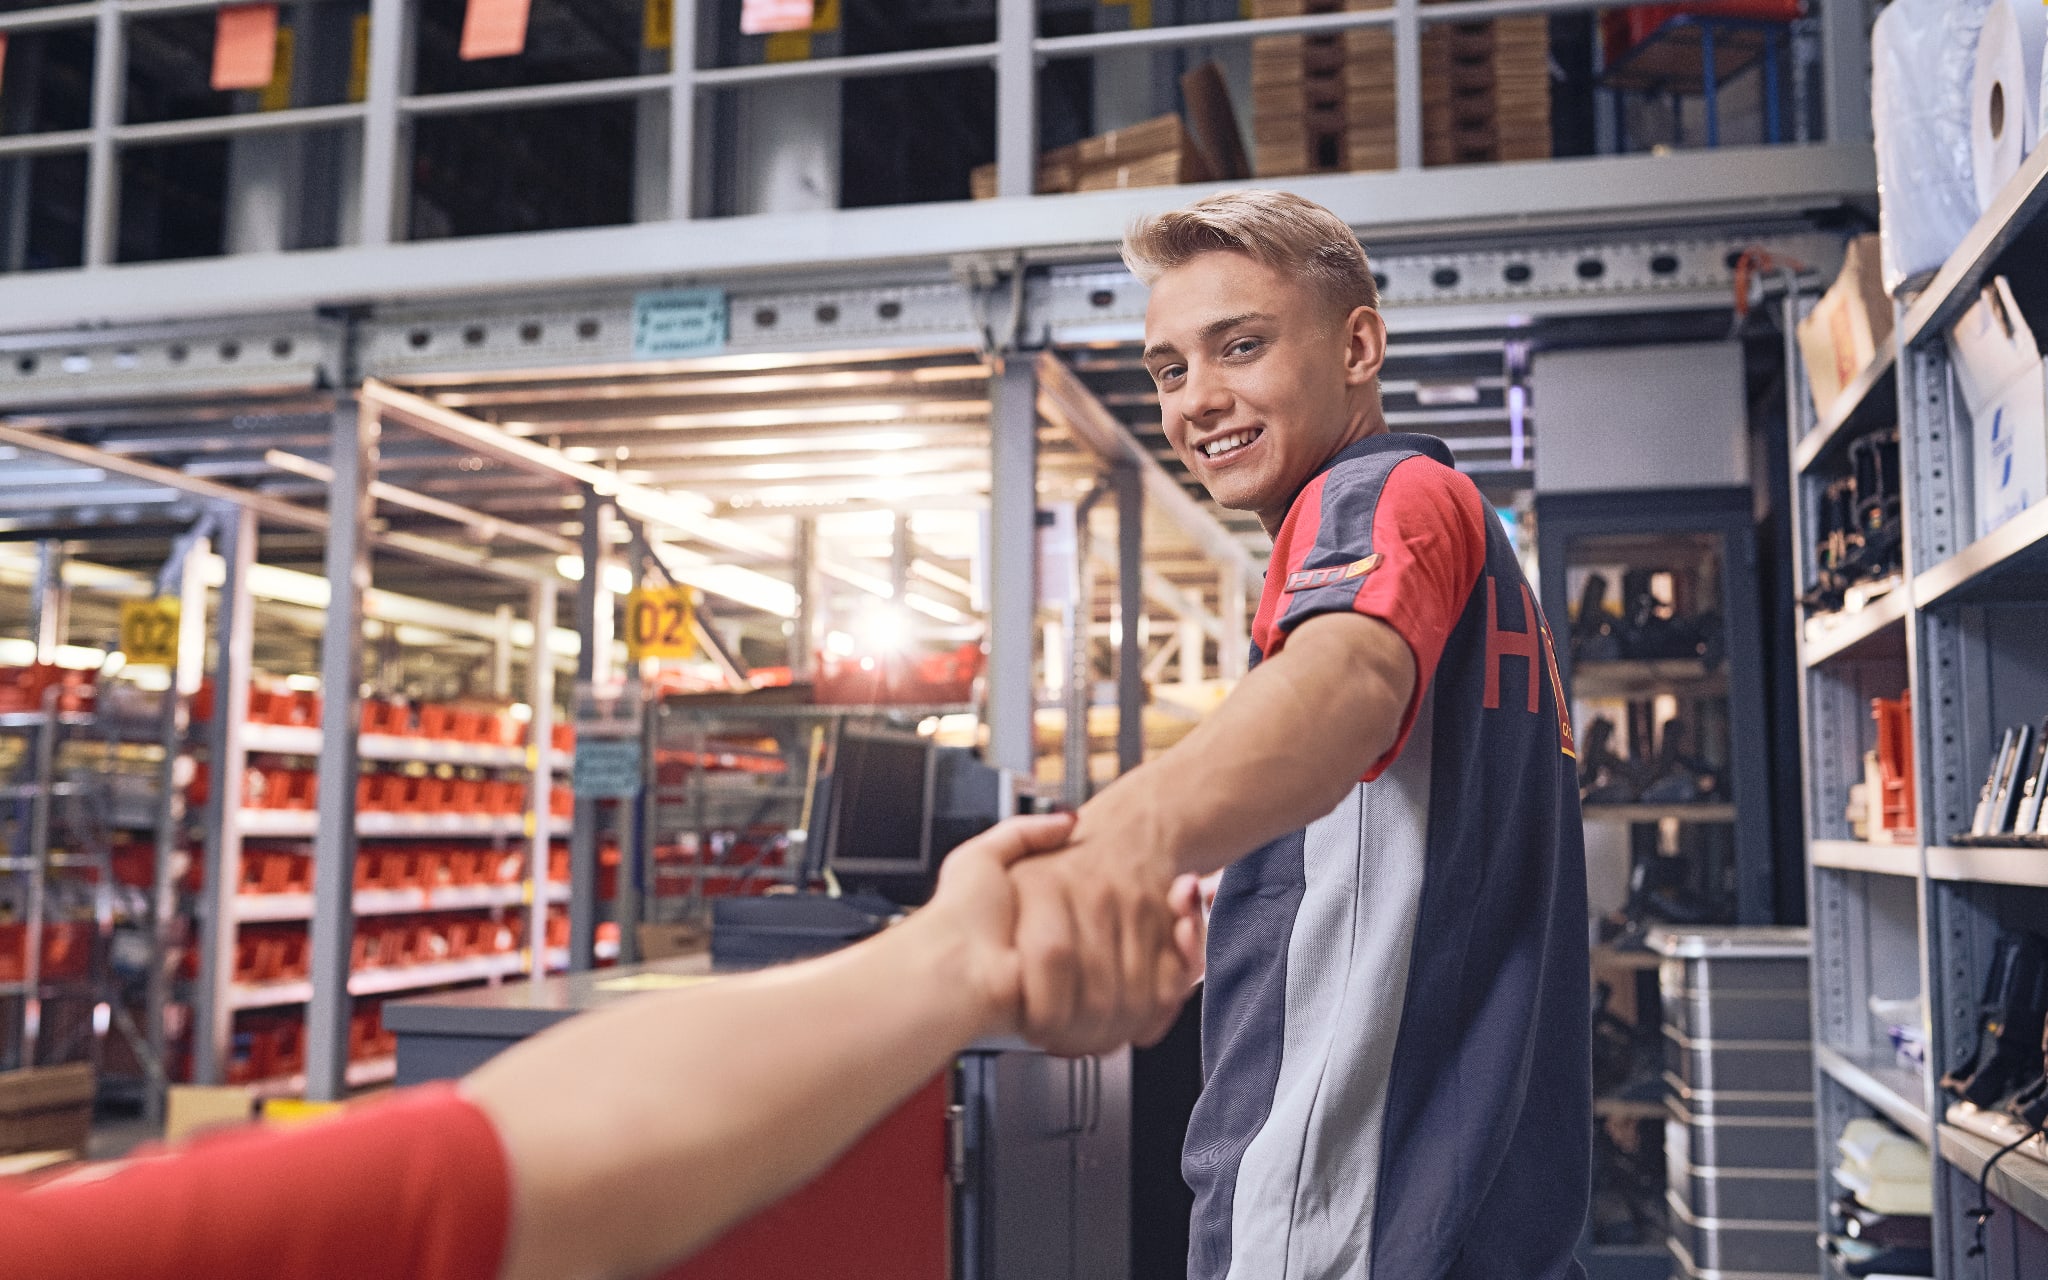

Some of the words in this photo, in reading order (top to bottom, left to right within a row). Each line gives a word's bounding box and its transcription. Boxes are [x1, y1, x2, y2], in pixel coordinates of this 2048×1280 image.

[127, 610, 178, 656] 02
[633, 600, 685, 646] 02
[1483, 575, 1552, 714] H
